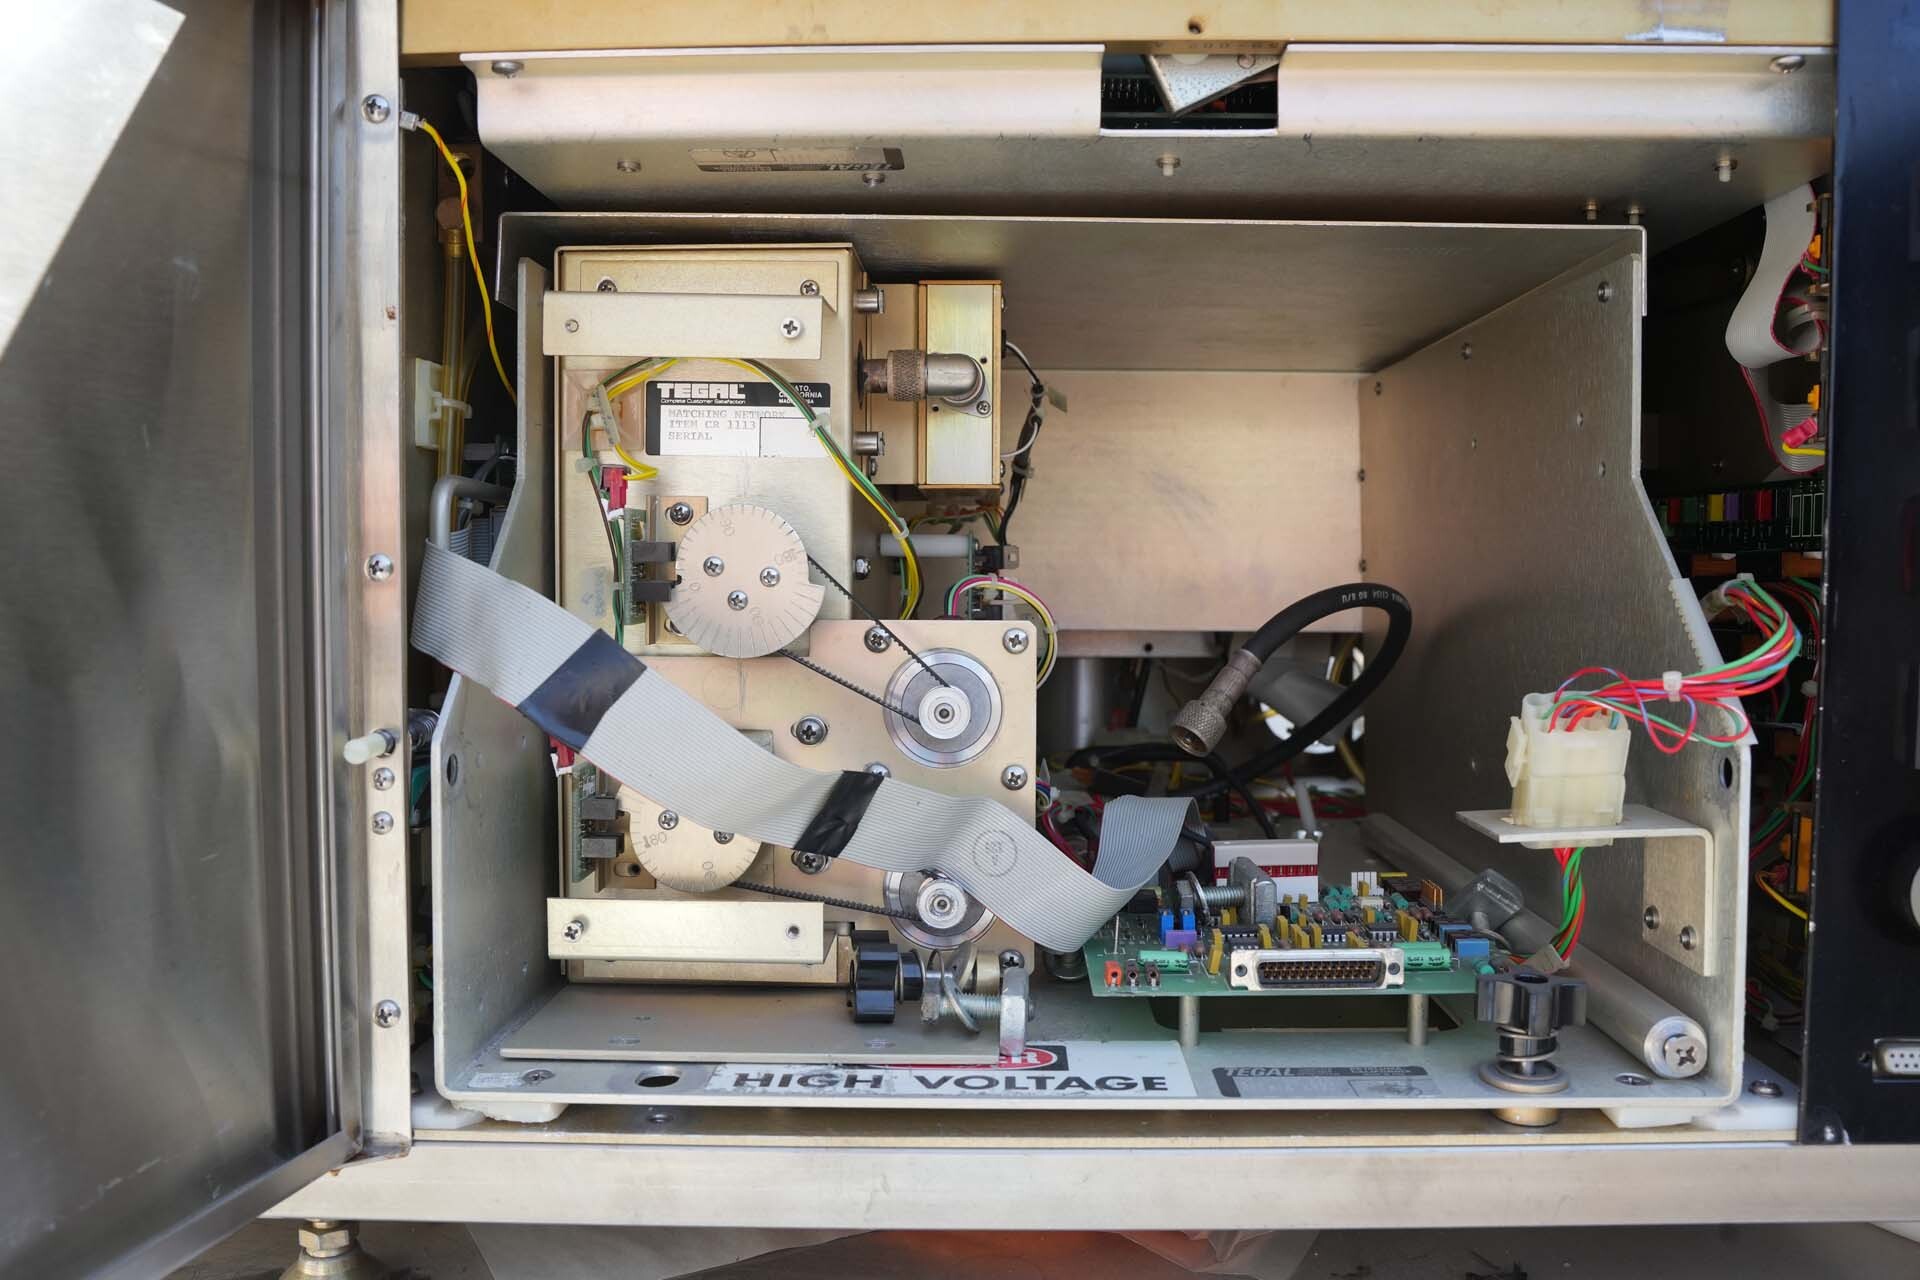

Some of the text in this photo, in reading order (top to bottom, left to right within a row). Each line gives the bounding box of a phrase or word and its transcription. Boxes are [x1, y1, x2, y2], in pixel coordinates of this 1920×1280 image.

[657, 383, 745, 399] TEGAL
[668, 409, 785, 418] MATCHING NETWORK
[670, 420, 756, 430] ITEM CR 1113
[668, 431, 713, 440] SERIAL
[1224, 1067, 1297, 1077] TEGAL
[732, 1073, 1169, 1092] HIGH VOLTAGE
